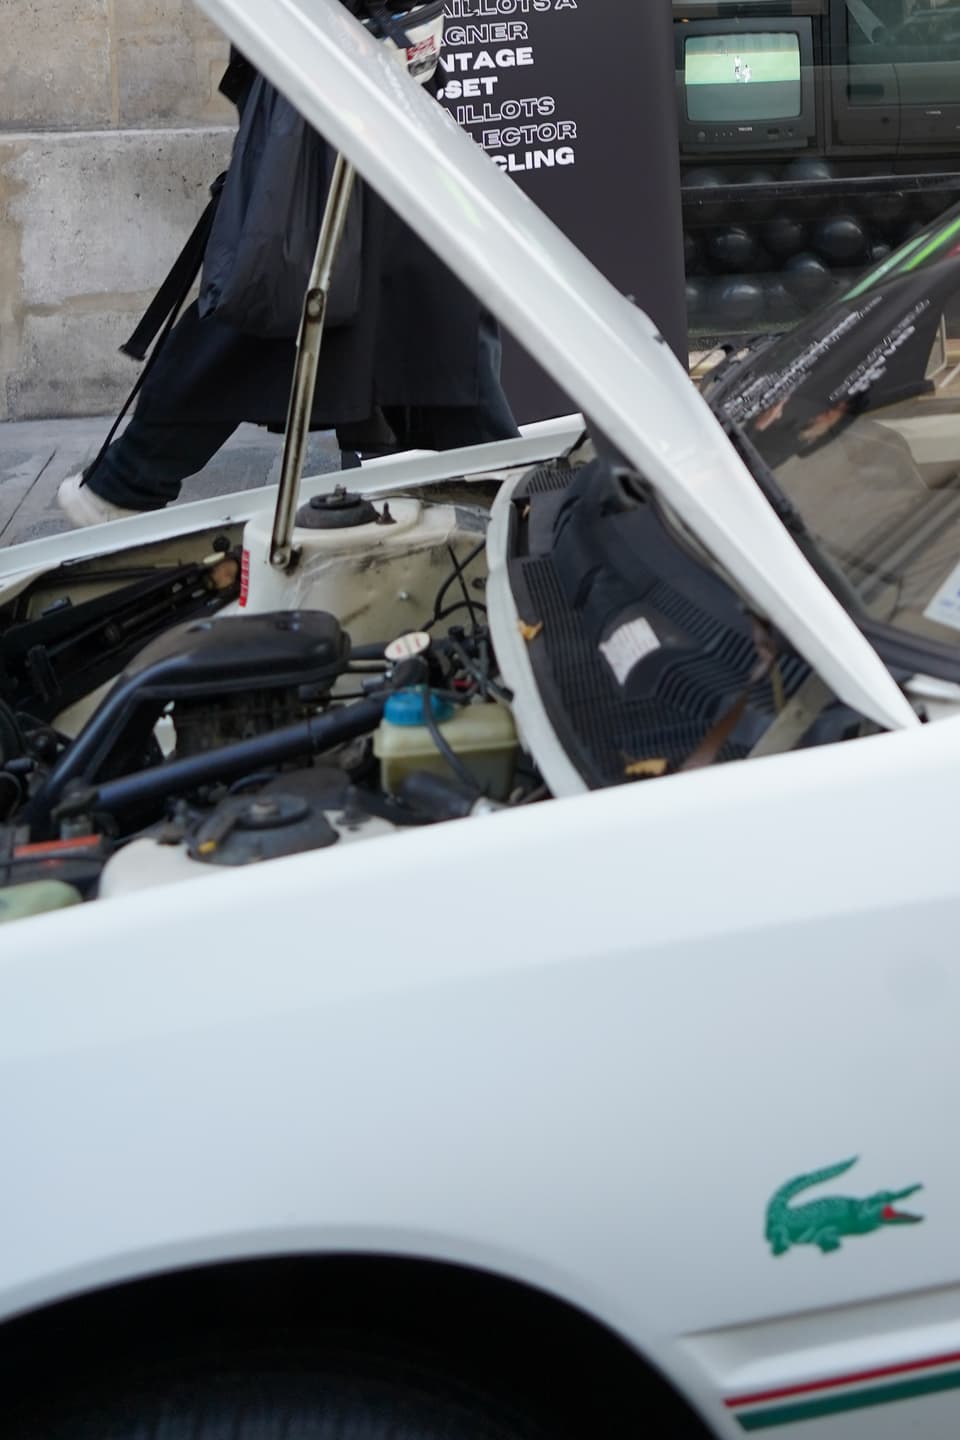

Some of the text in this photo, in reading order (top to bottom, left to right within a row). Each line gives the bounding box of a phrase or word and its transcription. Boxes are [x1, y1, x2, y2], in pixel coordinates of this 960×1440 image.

[440, 21, 529, 47] GNER
[439, 46, 535, 73] NTAGE
[436, 76, 498, 100] SET
[444, 96, 556, 126] ILLOTS
[468, 120, 577, 151] ECTOR
[491, 146, 575, 172] CLING
